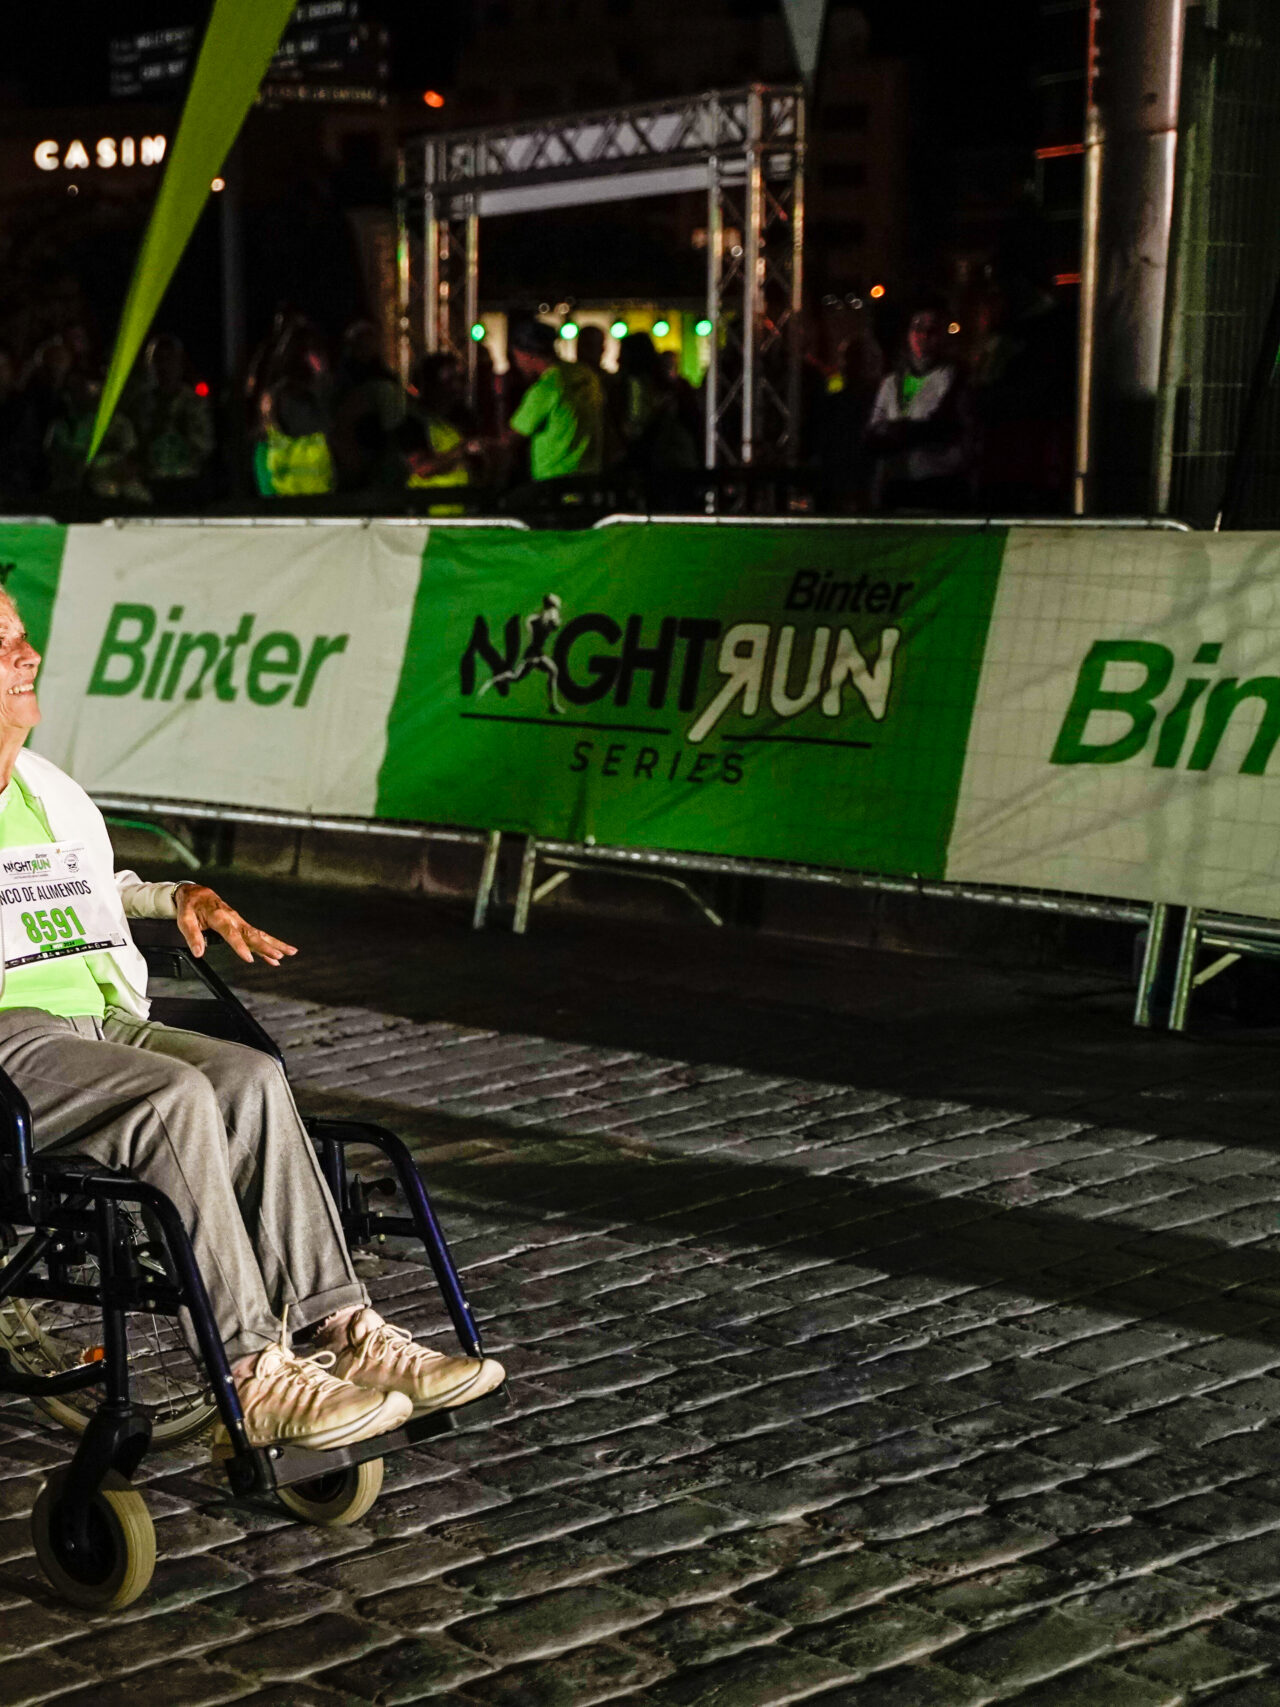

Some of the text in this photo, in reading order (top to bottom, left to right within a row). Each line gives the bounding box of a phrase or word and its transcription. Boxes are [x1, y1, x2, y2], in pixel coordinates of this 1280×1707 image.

[34, 135, 167, 171] CASIN
[783, 569, 915, 613] Binter
[87, 602, 351, 708] Binter
[1048, 639, 1280, 776] Bin
[569, 740, 745, 785] SERIES
[0, 880, 91, 906] NCO DE ALIMENTOS
[21, 905, 86, 944] 8591
